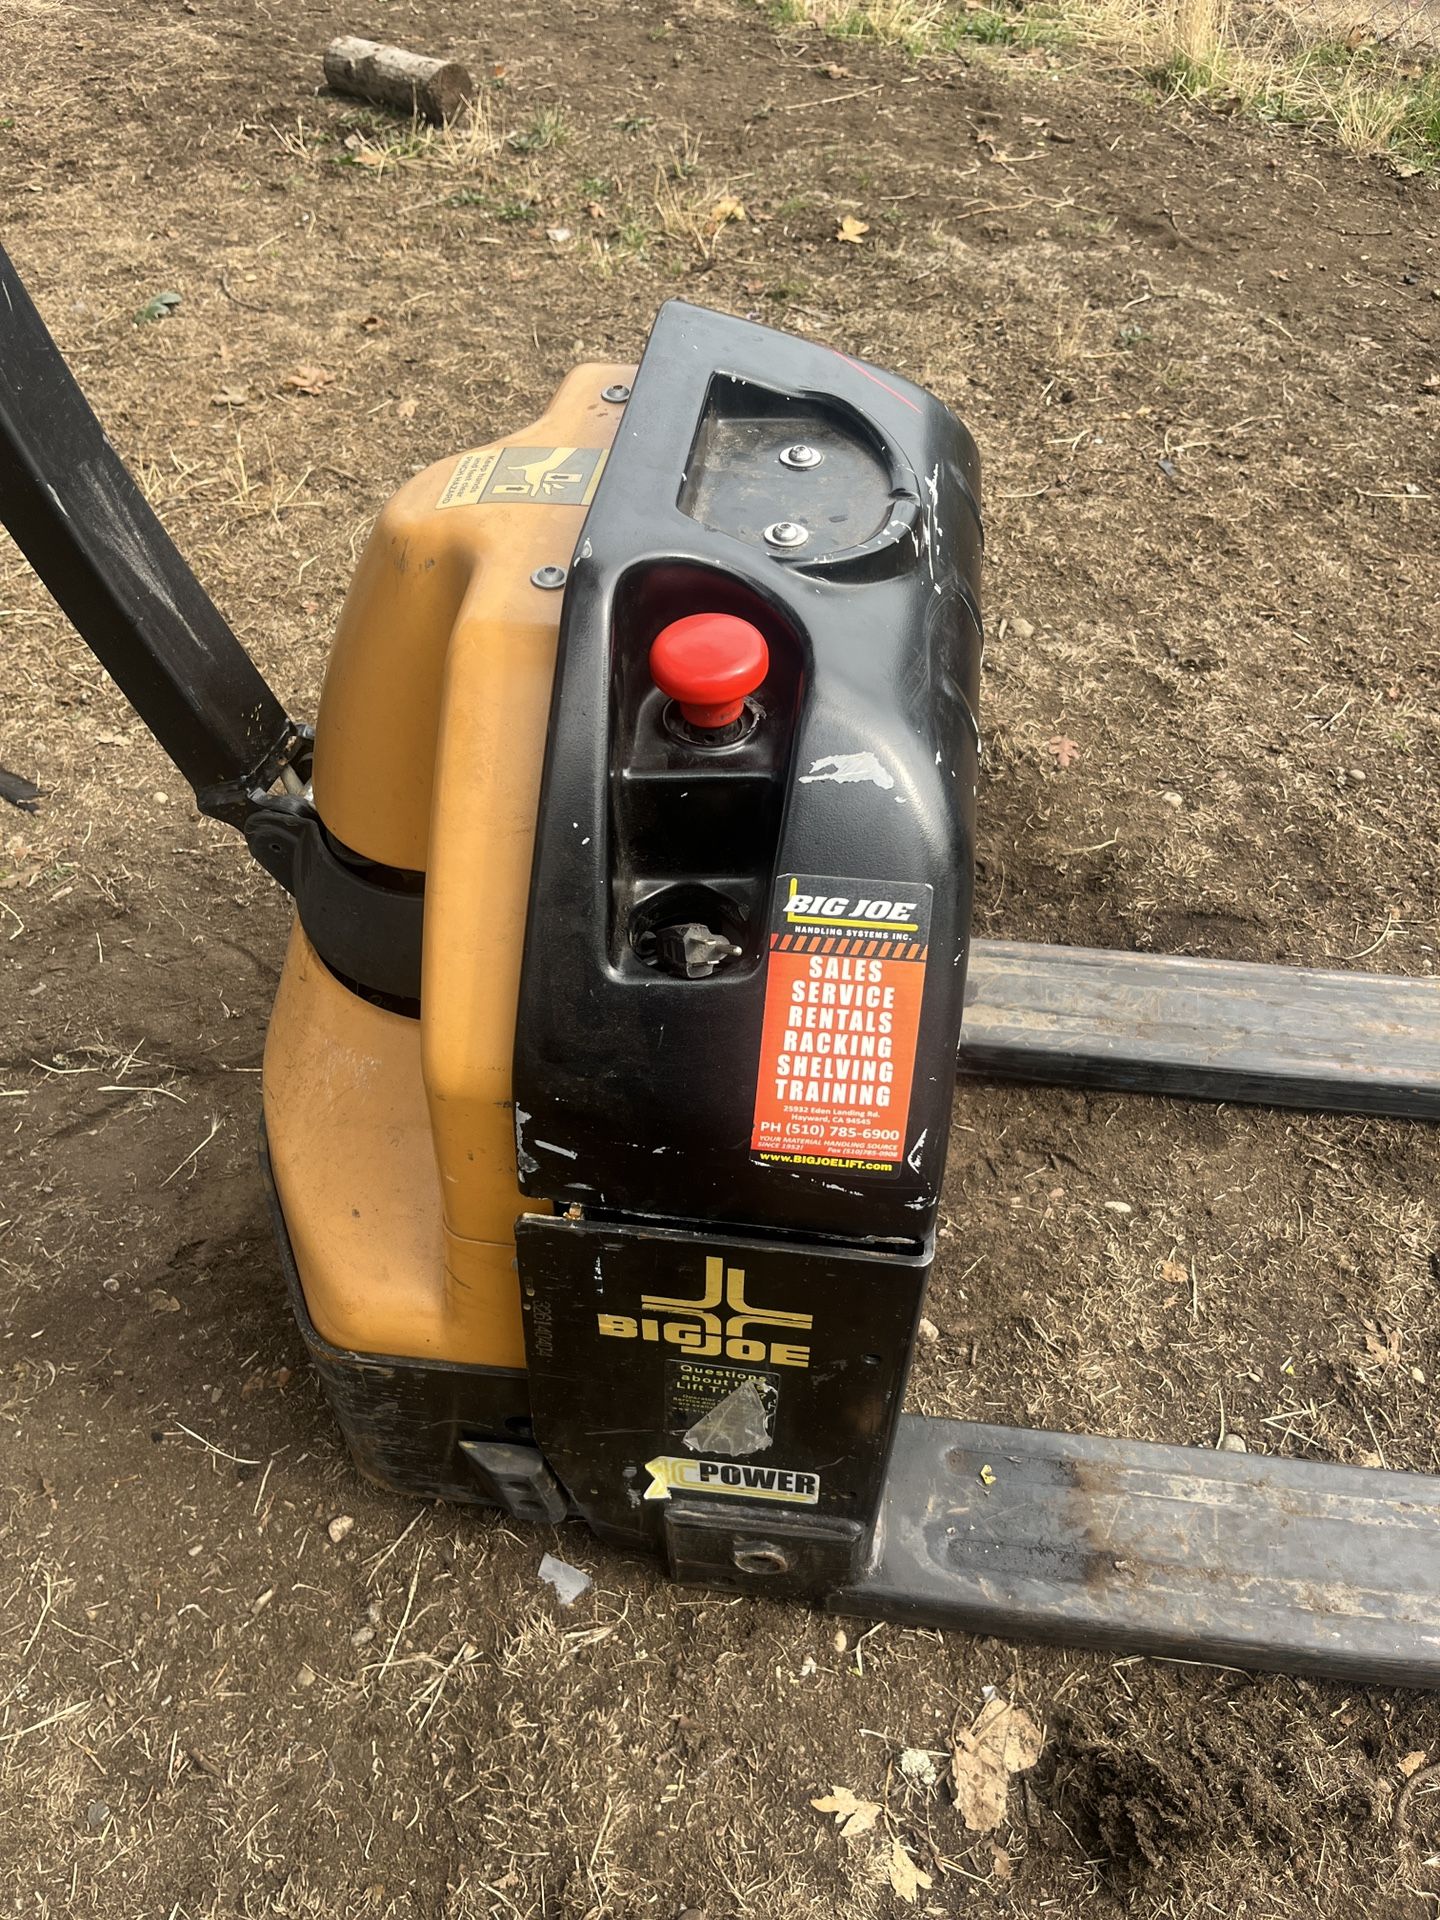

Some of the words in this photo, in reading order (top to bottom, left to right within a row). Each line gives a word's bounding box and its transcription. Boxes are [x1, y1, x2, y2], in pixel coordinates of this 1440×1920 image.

[783, 894, 850, 916] BIG
[848, 899, 917, 921] JOE
[794, 926, 843, 936] HANDLING
[846, 929, 889, 940] SYSTEMS
[892, 932, 912, 941] INC.
[809, 955, 883, 983] SALES
[791, 980, 896, 1009] SERVICE
[788, 1005, 893, 1034] RENTALS
[783, 1030, 892, 1058] RACKING
[777, 1054, 894, 1083] SHELVING
[775, 1078, 891, 1107] TRAINING
[783, 1105, 809, 1114] 25932
[810, 1107, 831, 1115] Eden
[833, 1108, 866, 1118] Landing
[867, 1110, 880, 1118] Rd.
[791, 1113, 831, 1123] Hayward,
[845, 1117, 871, 1125] 94545
[760, 1121, 782, 1133] PH
[785, 1123, 825, 1138] (510)
[829, 1126, 900, 1141] 785-6900
[759, 1135, 782, 1143] YOUR
[782, 1136, 822, 1146] MATERIAL
[823, 1140, 865, 1149] HANDLING
[866, 1143, 899, 1151] SOURCE
[827, 1146, 842, 1154] Fax
[759, 1153, 893, 1171] www.BIGJOELIFT.com
[680, 1364, 767, 1382] Questions
[681, 1374, 729, 1387] about
[676, 1381, 704, 1392] Lift
[699, 1462, 817, 1495] POWER
